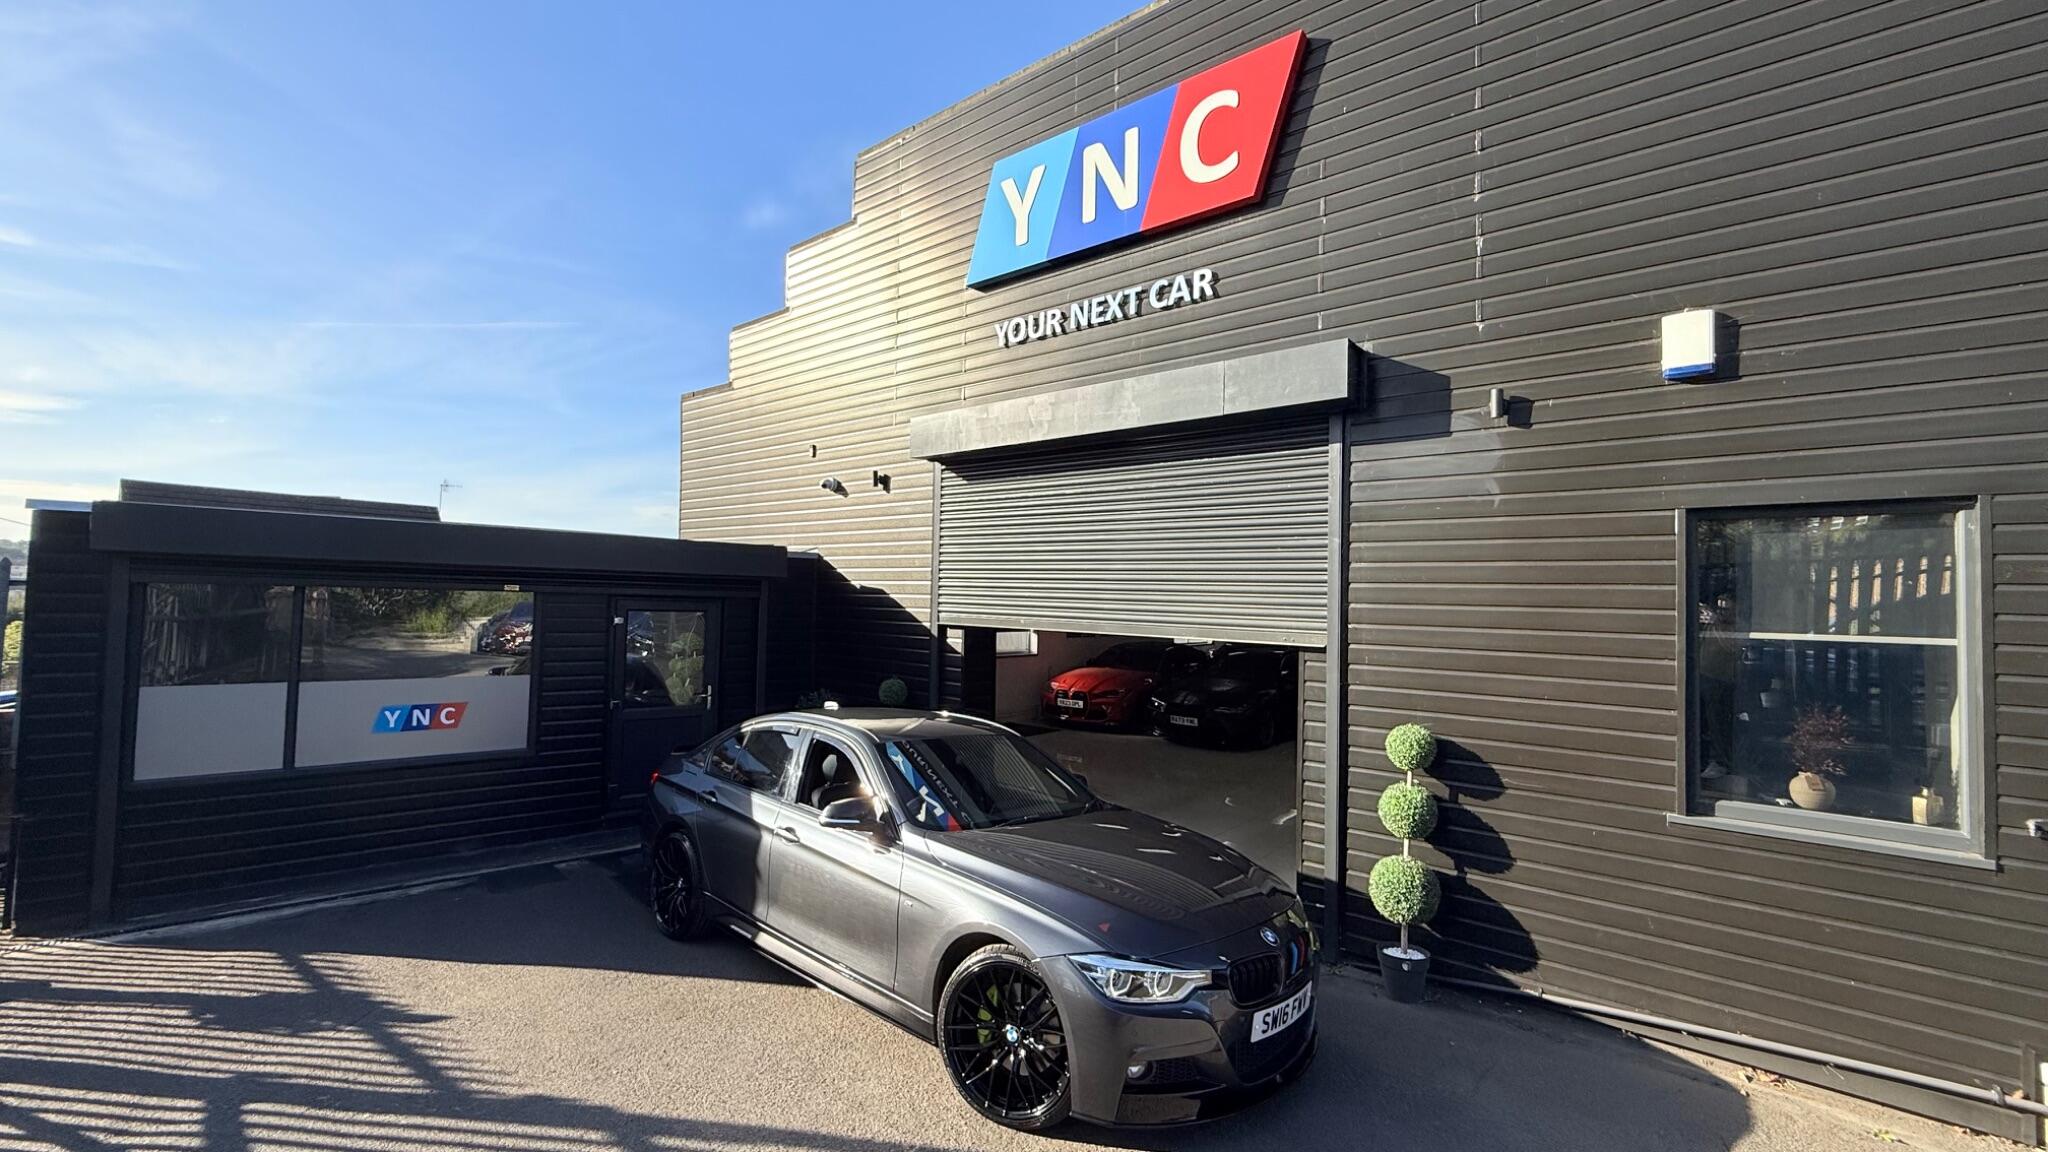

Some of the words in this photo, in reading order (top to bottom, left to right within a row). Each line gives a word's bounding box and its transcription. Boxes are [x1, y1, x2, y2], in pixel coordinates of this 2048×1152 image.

[1000, 89, 1240, 247] YNC
[993, 307, 1063, 347] YOUR
[1069, 286, 1143, 329] NEXT
[1149, 268, 1214, 310] CAR
[384, 707, 456, 728] YNC
[1261, 1003, 1290, 1035] SW16
